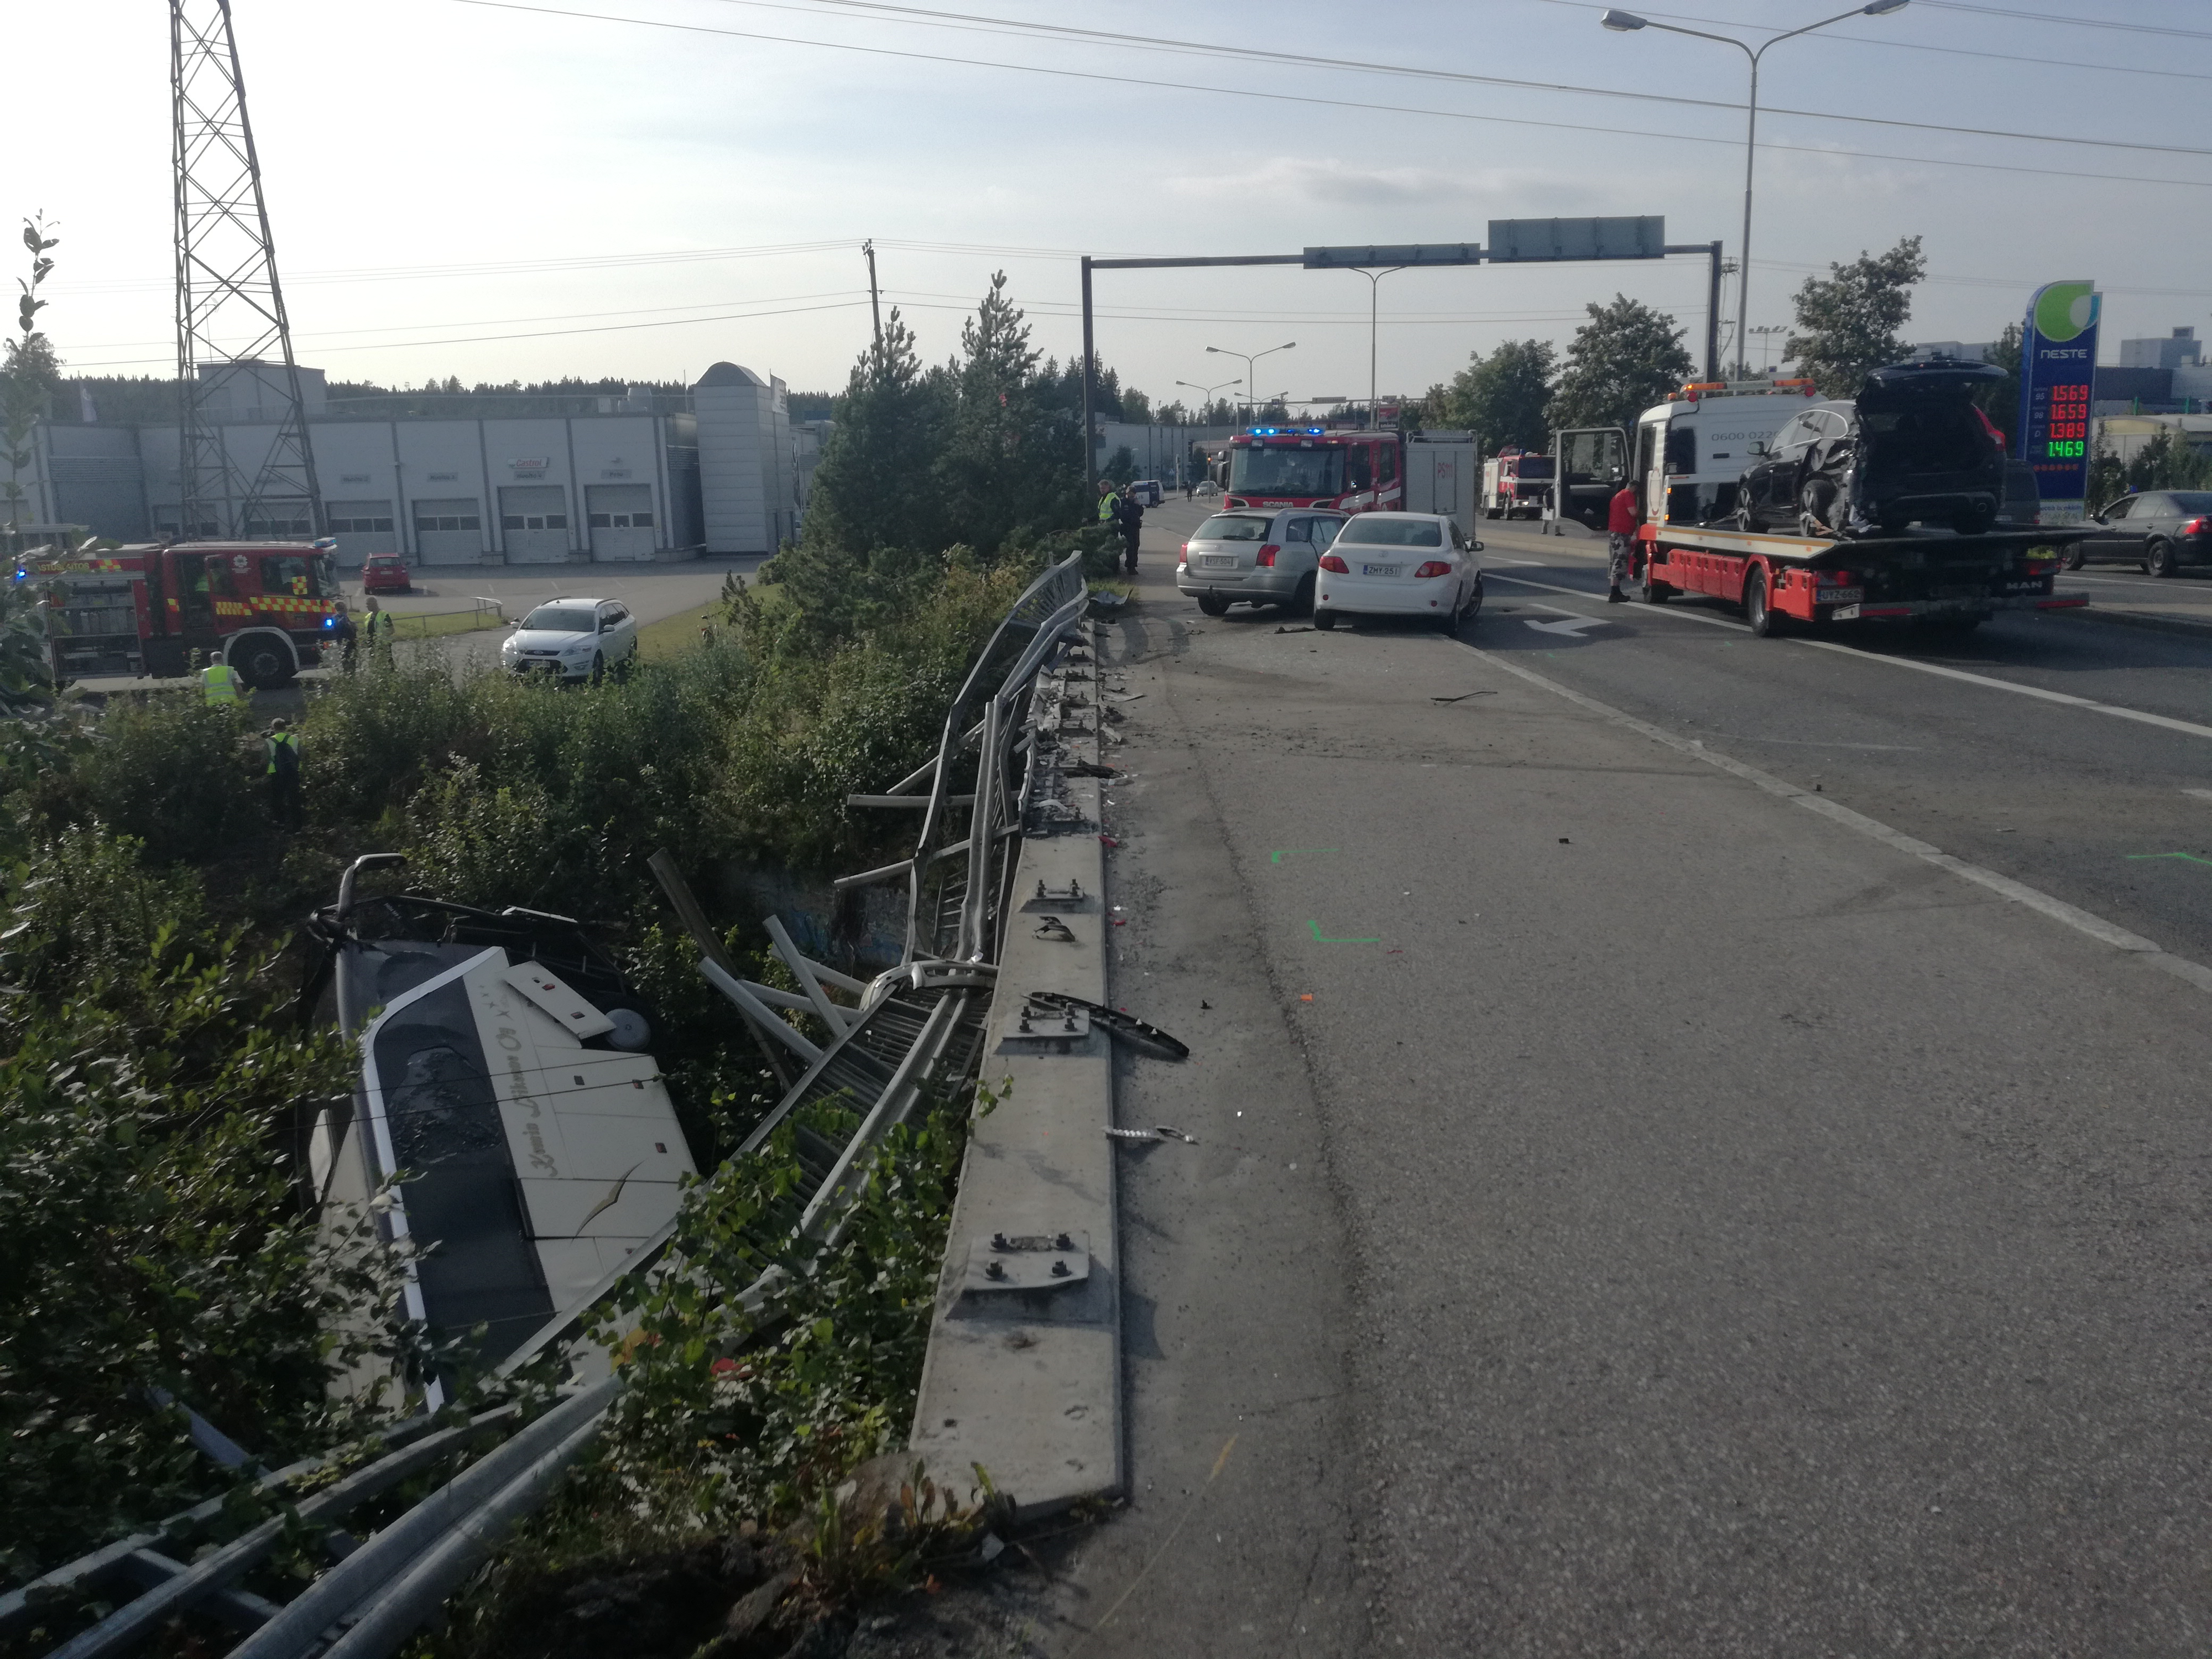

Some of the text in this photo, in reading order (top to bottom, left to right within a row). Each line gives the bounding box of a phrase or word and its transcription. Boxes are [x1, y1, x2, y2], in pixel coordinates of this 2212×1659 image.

[2040, 348, 2088, 359] NESTE
[1711, 432, 1745, 441] 0600
[516, 459, 542, 467] Castrol
[1438, 462, 1453, 479] PS111
[1369, 566, 1397, 575] ZMY-251
[2006, 581, 2043, 589] MAN
